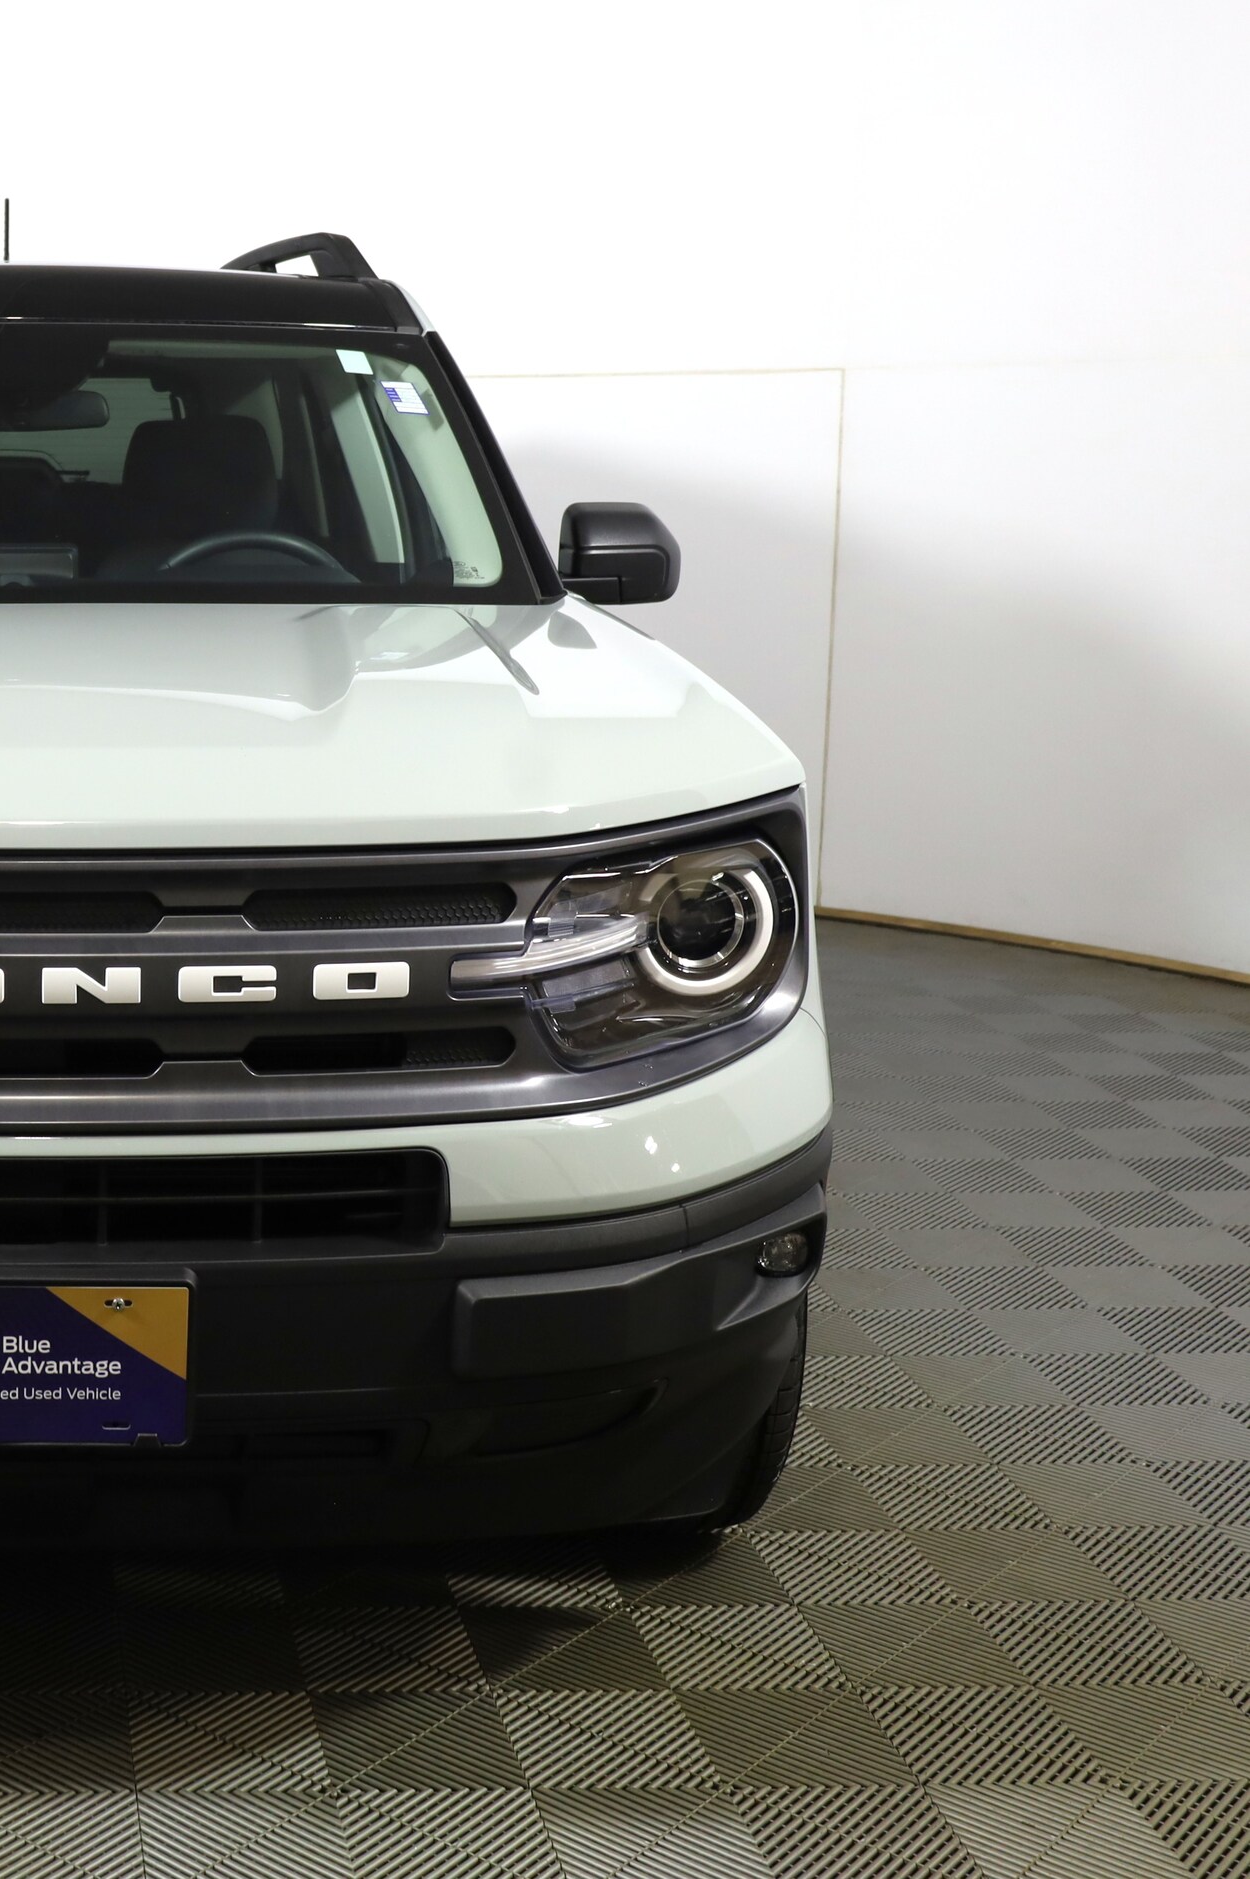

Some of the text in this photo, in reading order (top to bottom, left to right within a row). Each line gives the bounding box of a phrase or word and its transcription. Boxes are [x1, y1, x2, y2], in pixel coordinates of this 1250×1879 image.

[2, 1335, 51, 1354] Blue
[1, 1357, 122, 1378] Advantage
[23, 1387, 62, 1401] Used
[66, 1387, 122, 1401] Vehicle
